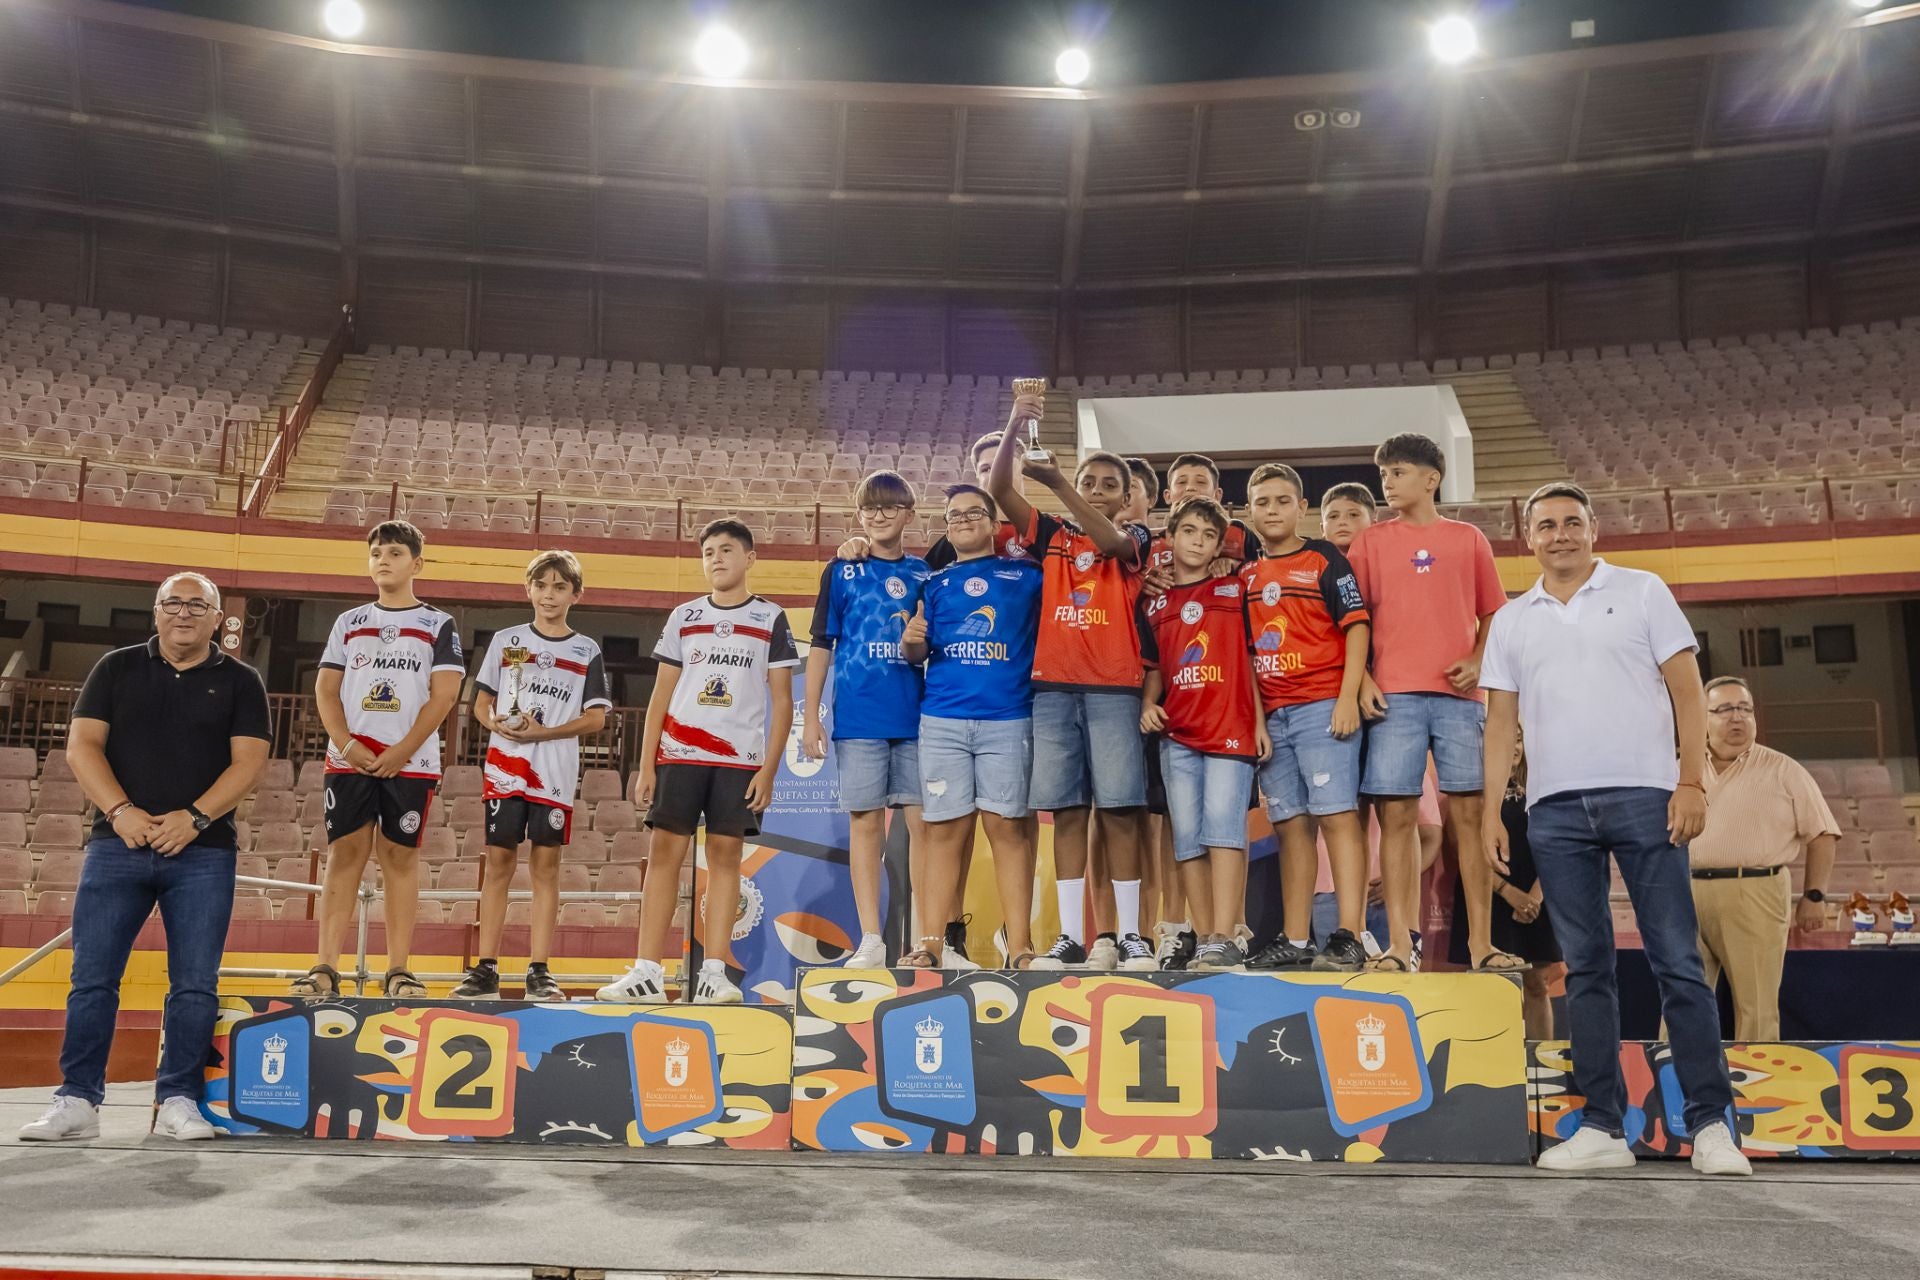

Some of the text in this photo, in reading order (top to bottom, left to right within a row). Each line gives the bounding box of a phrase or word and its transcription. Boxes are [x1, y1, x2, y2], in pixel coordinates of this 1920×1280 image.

[1152, 550, 1173, 567] 13
[843, 562, 866, 580] 81
[1147, 594, 1168, 617] 26
[350, 614, 368, 625] 40
[684, 608, 704, 622] 22
[376, 650, 422, 660] PINTURA
[710, 646, 756, 658] PINTURAS
[868, 641, 904, 659] FERRE
[943, 641, 1010, 661] FERRESOL
[372, 657, 422, 673] MARIN
[707, 653, 753, 669] MARIN
[532, 675, 575, 693] PINTURAS
[1172, 665, 1225, 686] RRESOL
[528, 682, 572, 703] MARIN
[323, 786, 336, 814] 0
[771, 790, 808, 801] QUETAS
[812, 791, 825, 800] DE
[489, 799, 501, 817] 9
[1121, 1015, 1181, 1104] 1
[434, 1034, 493, 1110] 2
[894, 1080, 932, 1090] ROQUETAS
[945, 1081, 963, 1089] MAR
[1861, 1066, 1914, 1131] 3
